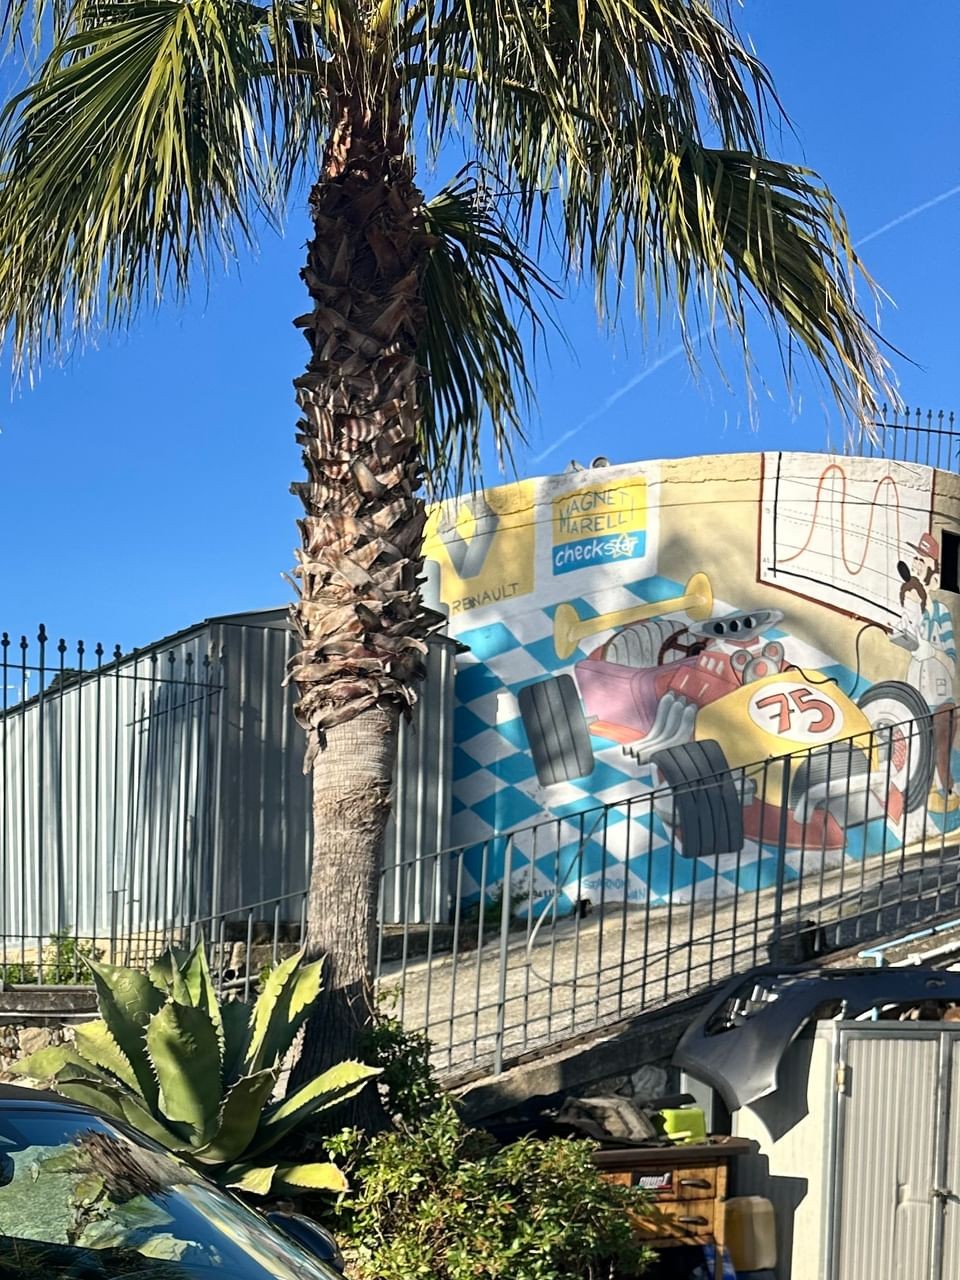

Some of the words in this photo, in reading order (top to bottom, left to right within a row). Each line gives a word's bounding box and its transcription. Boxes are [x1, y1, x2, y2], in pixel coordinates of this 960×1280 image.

[555, 536, 639, 567] checkstar
[451, 582, 520, 616] RENAULT
[755, 687, 836, 735] 75
